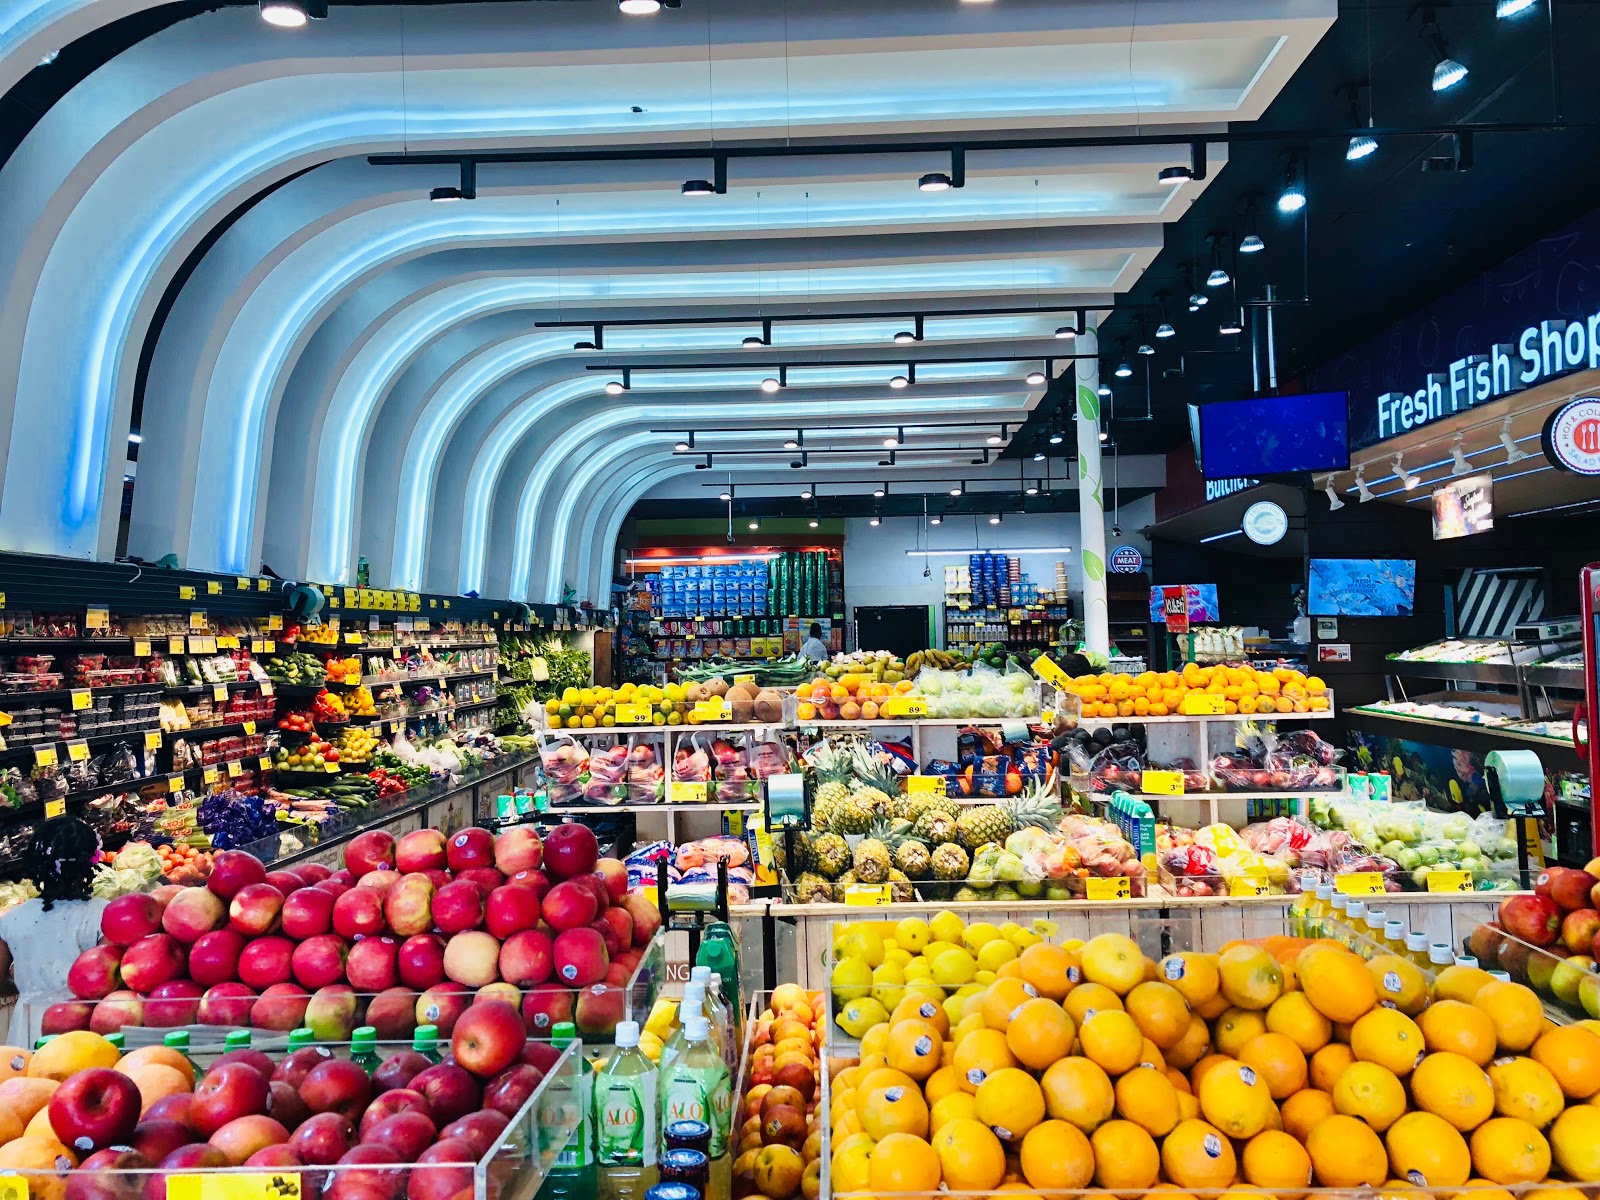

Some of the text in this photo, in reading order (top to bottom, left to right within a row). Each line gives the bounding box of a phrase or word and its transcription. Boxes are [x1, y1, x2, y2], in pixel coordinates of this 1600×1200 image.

[1378, 373, 1443, 438] Fresh
[1449, 344, 1511, 412] Fish
[1562, 422, 1573, 440] HOT
[1568, 448, 1596, 466] SALAD
[1117, 557, 1137, 565] MEAT
[605, 1107, 638, 1126] ALO
[668, 1101, 705, 1120] ALO
